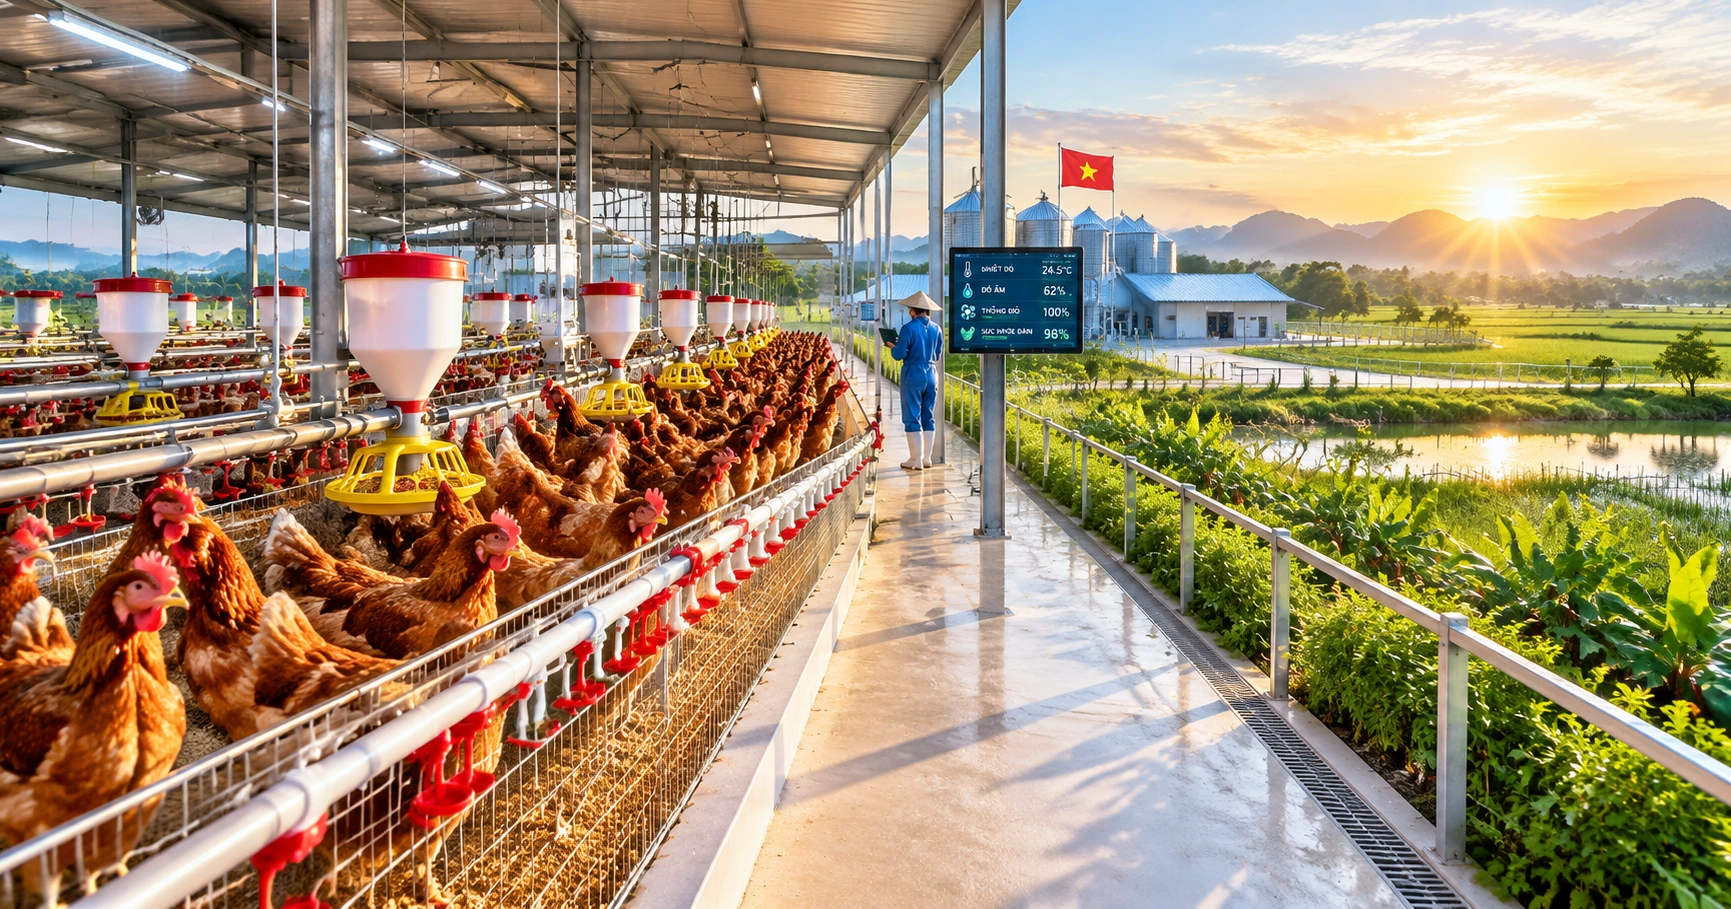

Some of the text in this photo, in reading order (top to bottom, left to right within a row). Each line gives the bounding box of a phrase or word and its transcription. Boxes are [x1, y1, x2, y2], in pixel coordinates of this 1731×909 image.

[1042, 265, 1072, 275] 24.5°C
[1043, 285, 1066, 296] 62%
[1043, 307, 1070, 317] 100%
[1044, 328, 1070, 340] 98%
